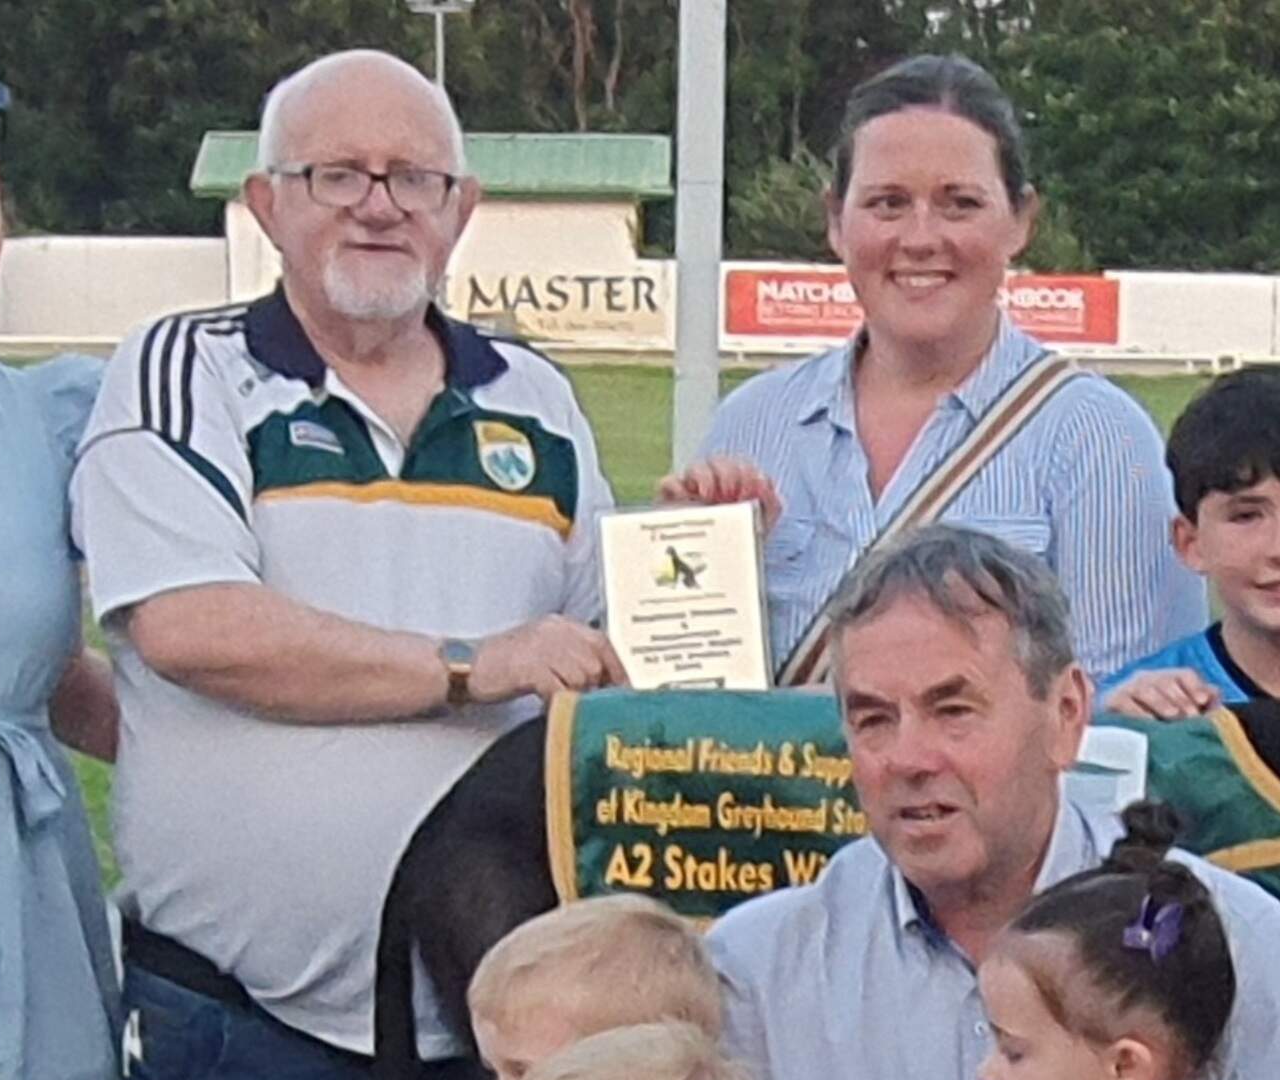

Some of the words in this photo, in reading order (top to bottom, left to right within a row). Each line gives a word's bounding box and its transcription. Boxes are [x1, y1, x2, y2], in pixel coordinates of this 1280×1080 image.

[468, 274, 658, 312] MASTER
[606, 734, 694, 779] Regional
[699, 737, 773, 776] Friends
[801, 741, 854, 788] Supp
[596, 787, 617, 825] of
[623, 788, 711, 836] Kingdom
[717, 791, 827, 838] Greyhound
[832, 798, 867, 835] Sta
[605, 843, 654, 888] A2
[664, 844, 774, 891] Stakes
